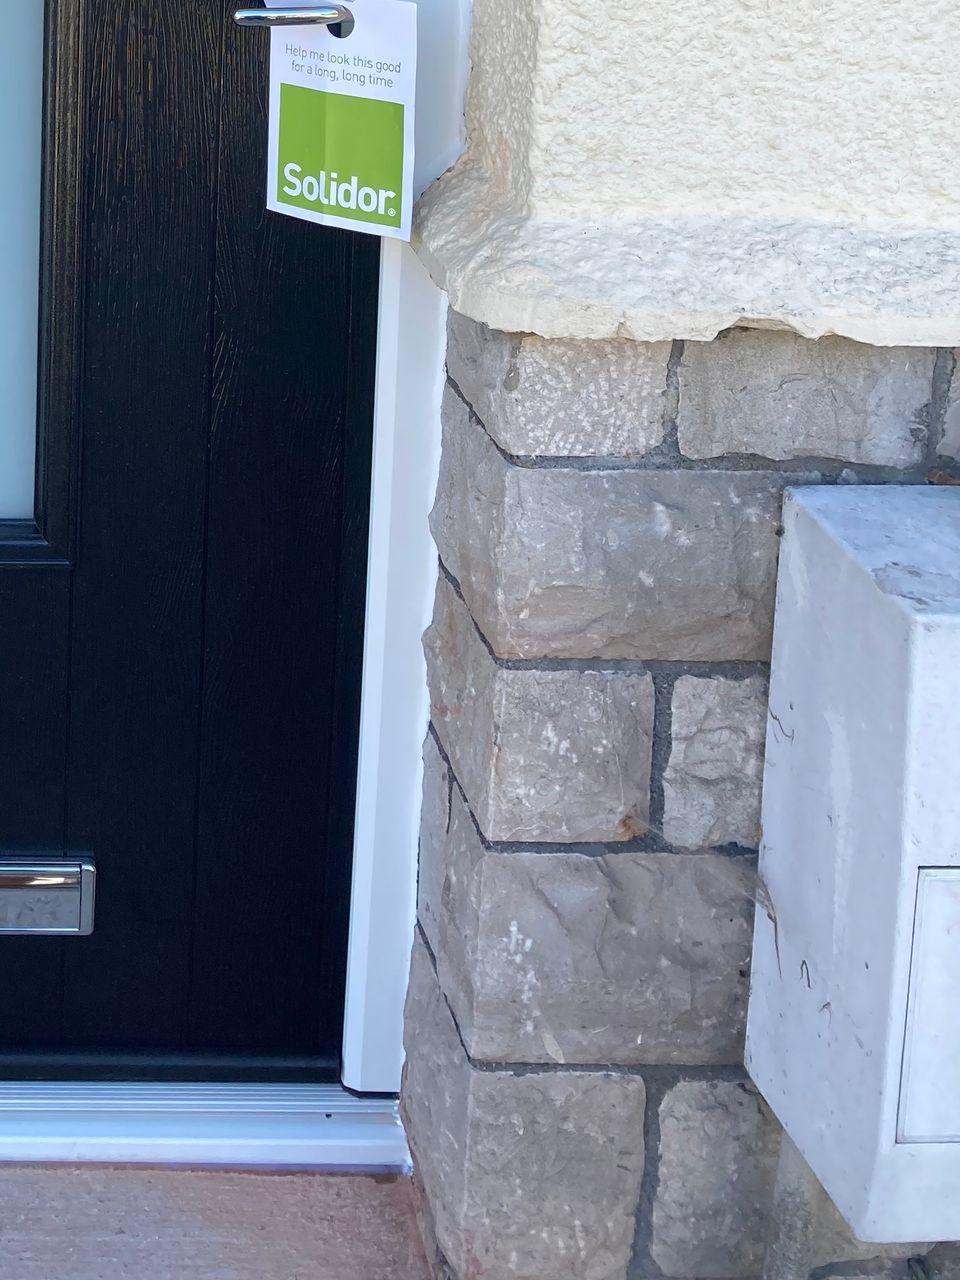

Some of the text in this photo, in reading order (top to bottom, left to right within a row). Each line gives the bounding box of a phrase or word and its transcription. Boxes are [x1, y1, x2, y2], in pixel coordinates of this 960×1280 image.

[285, 43, 402, 74] Help me look this good
[291, 60, 394, 88] for a long, long time
